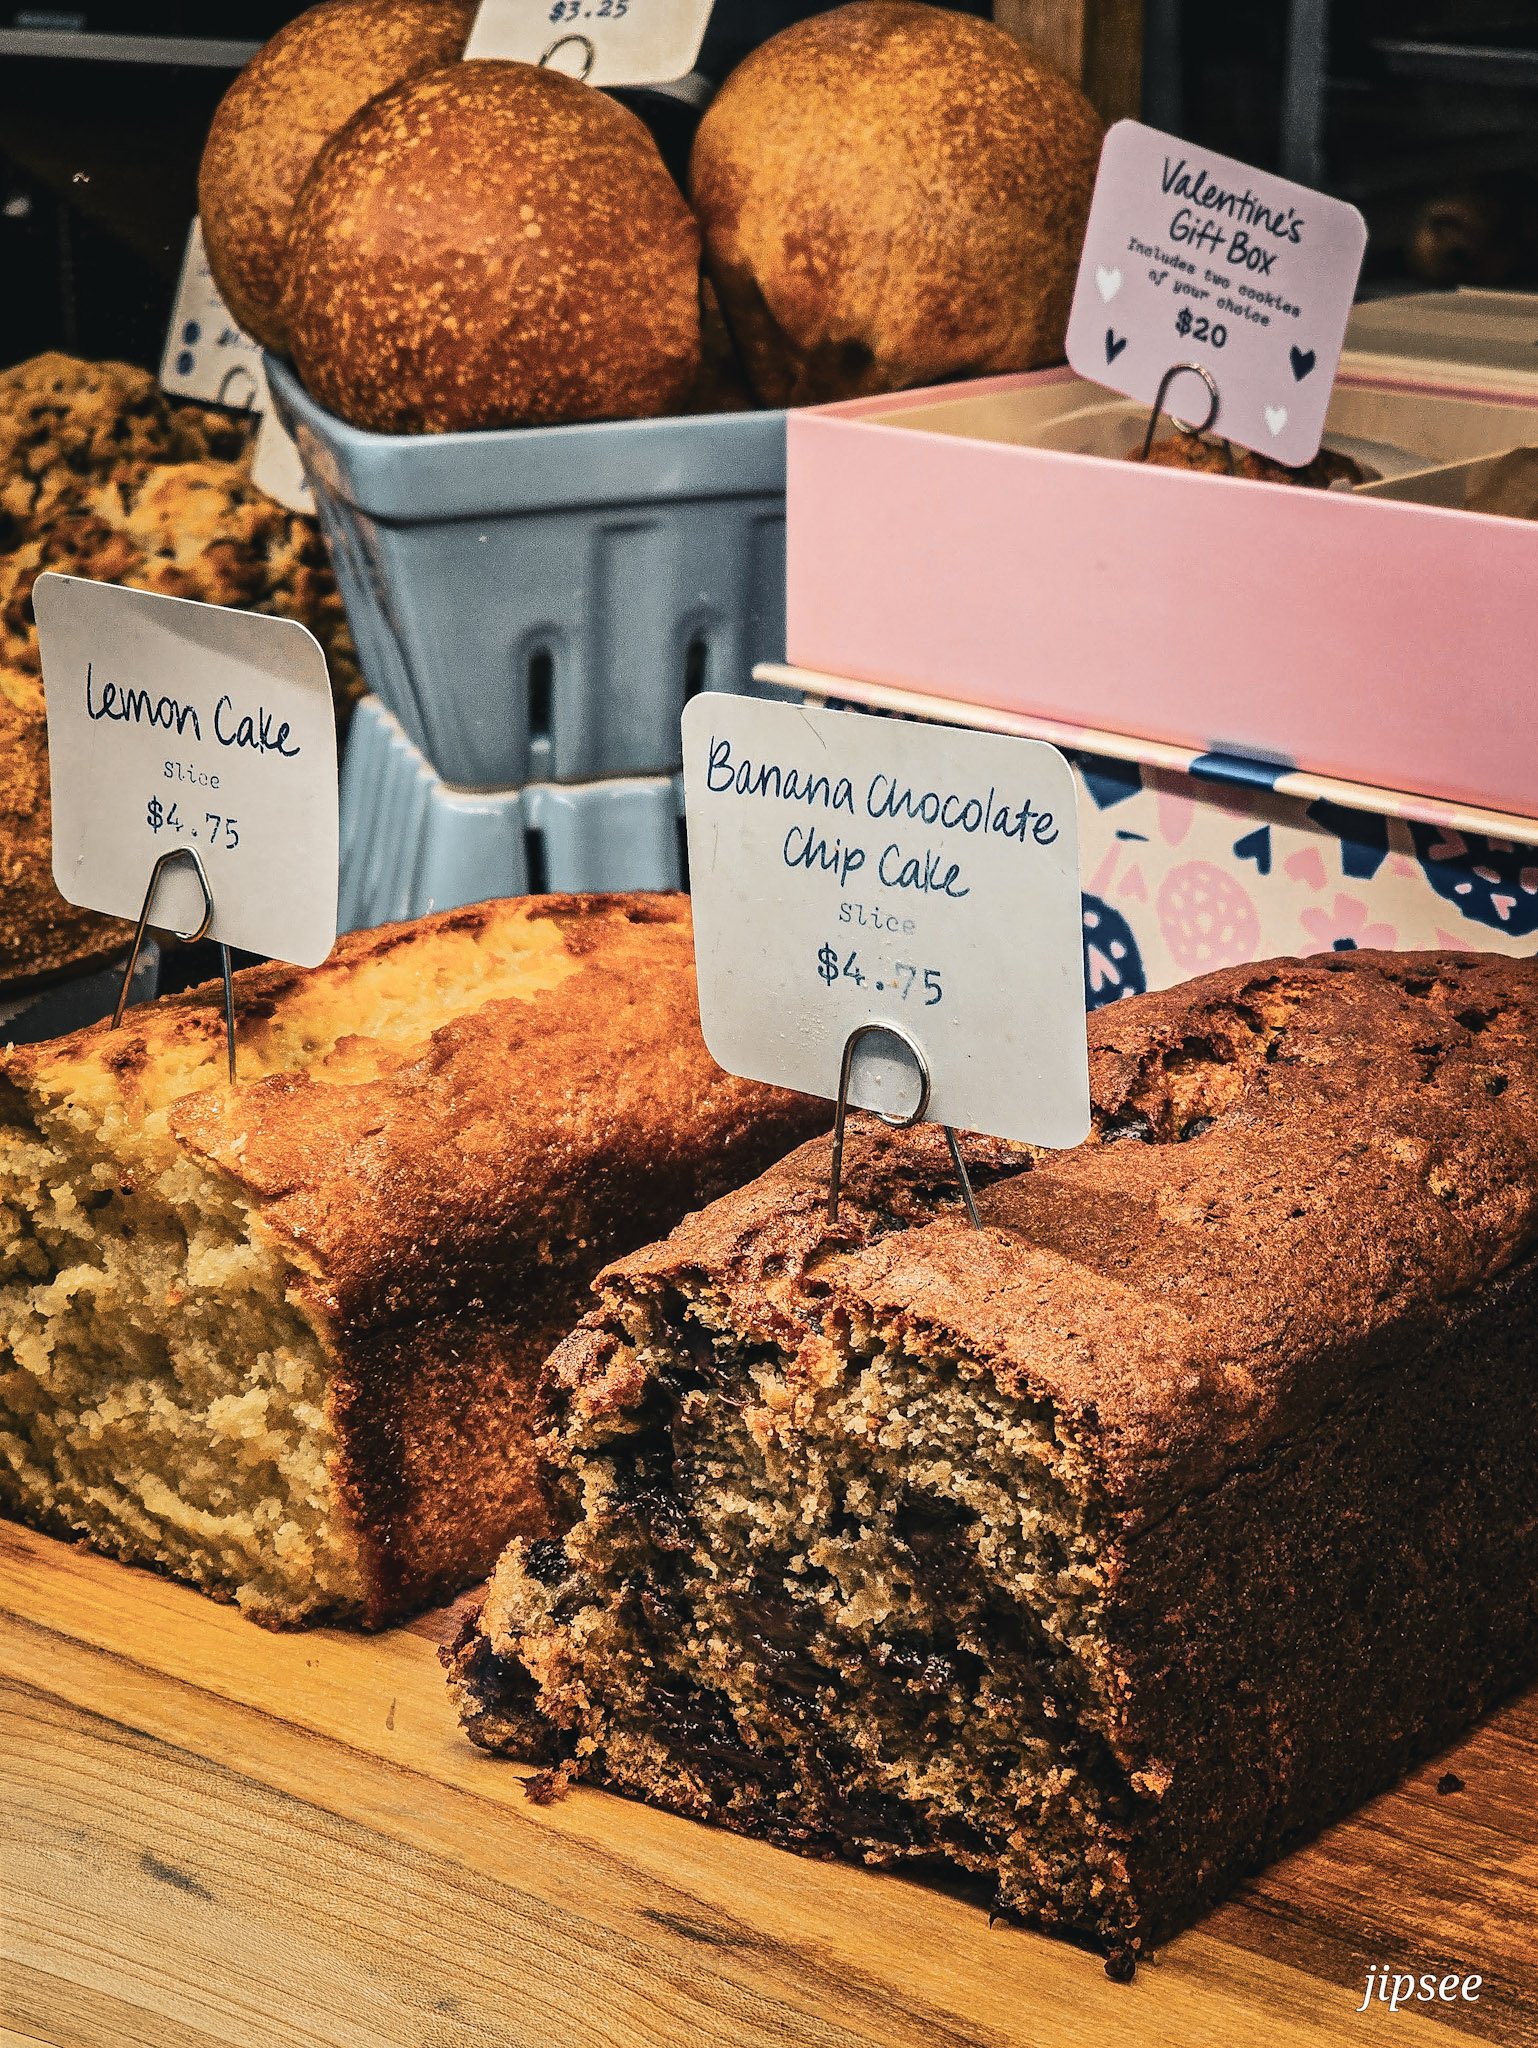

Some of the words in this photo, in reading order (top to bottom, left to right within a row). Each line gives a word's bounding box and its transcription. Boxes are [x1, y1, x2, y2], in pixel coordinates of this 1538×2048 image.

[548, 0, 629, 23] $3.25
[1161, 156, 1304, 243] Valentine's
[1169, 207, 1226, 254] Gift
[1226, 231, 1278, 276] Box
[1127, 236, 1197, 275] Includes
[1204, 269, 1231, 289] two
[1238, 285, 1301, 318] cookies
[1149, 270, 1169, 286] of
[1172, 280, 1210, 299] your
[1216, 297, 1271, 327] choice
[1175, 306, 1227, 349] $20
[214, 695, 301, 757] Cake
[163, 760, 220, 789] Slice
[706, 735, 854, 815] Banana
[866, 774, 1059, 845] Chocolate
[146, 795, 239, 850] $4.75
[783, 826, 865, 887] Chip
[878, 843, 970, 898] Cake
[838, 902, 917, 936] Slice
[817, 942, 943, 1006] $4.75
